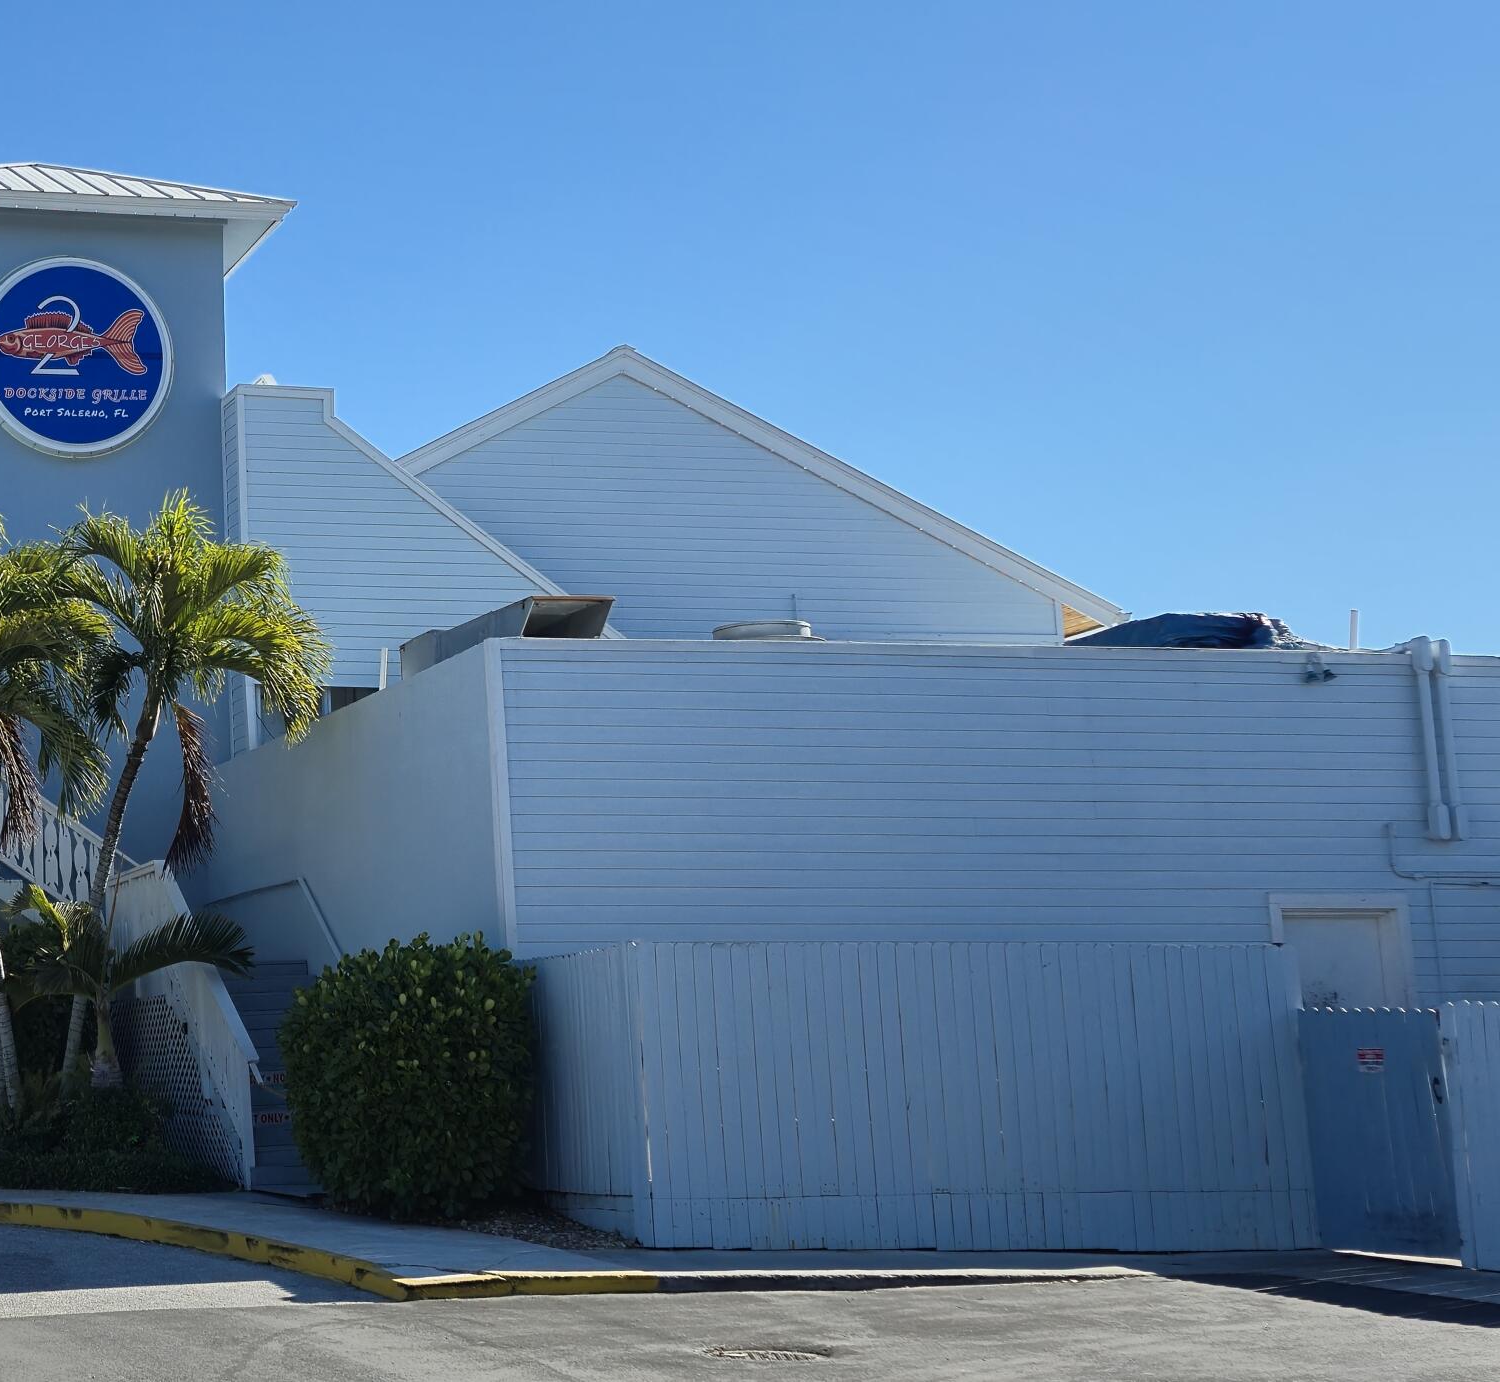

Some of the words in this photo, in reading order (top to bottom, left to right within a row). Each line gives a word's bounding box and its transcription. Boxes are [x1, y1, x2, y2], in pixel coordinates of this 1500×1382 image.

[4, 387, 86, 401] DOCKSIDE
[91, 388, 148, 404] GRILLE
[113, 408, 129, 418] FL
[260, 1113, 283, 1124] ONLY
